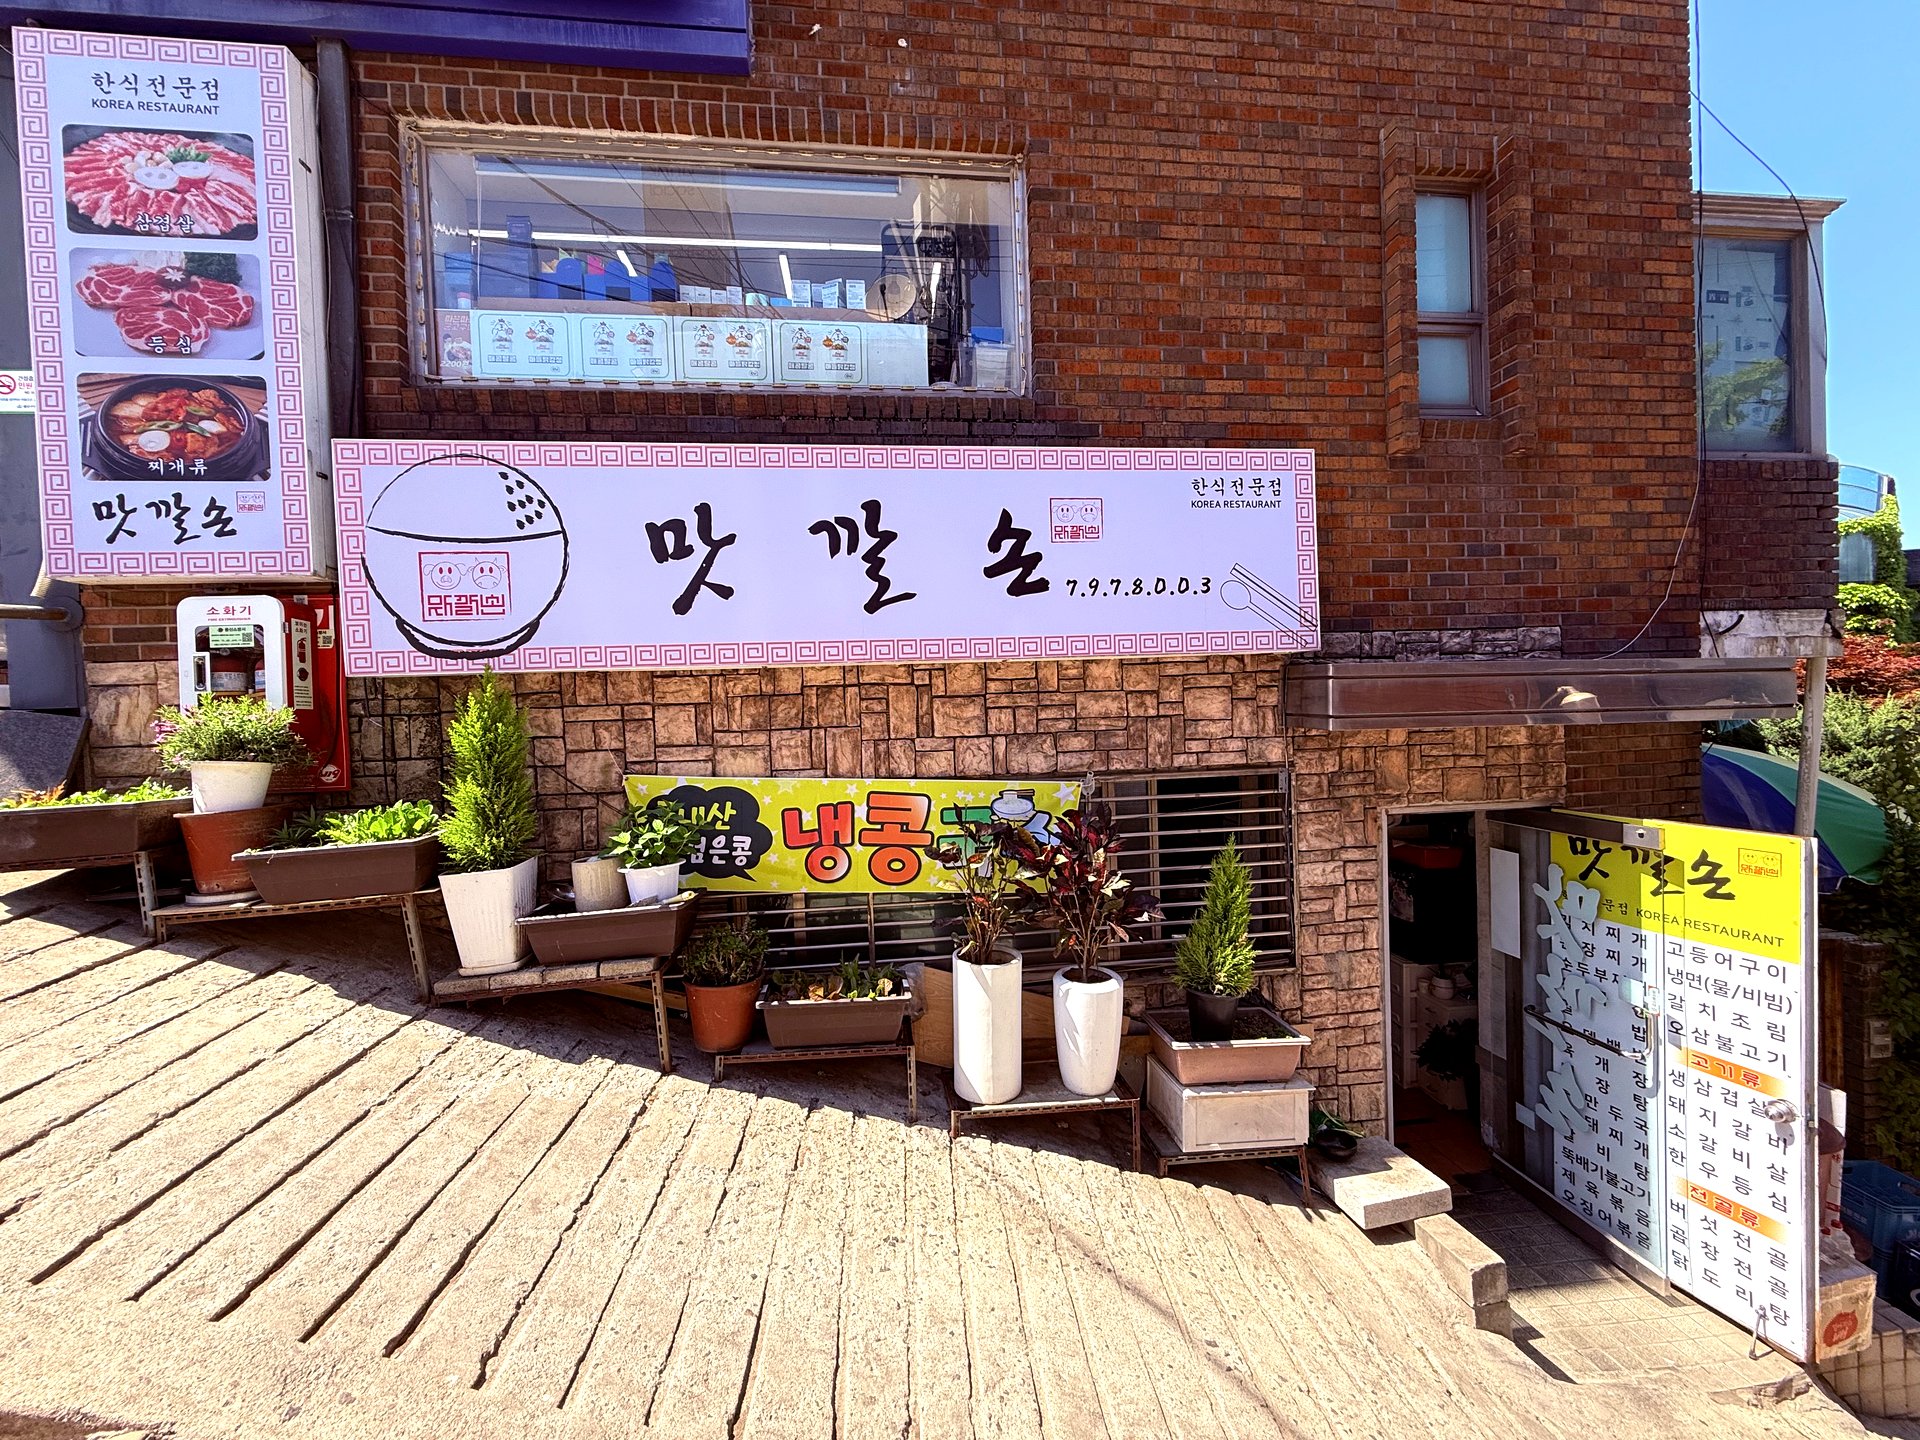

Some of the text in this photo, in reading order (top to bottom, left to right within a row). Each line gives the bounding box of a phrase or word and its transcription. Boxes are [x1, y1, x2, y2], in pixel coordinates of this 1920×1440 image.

[91, 71, 220, 100] 한식전문점
[91, 98, 220, 115] KOREA RESTAURANT
[135, 213, 195, 234] 삼겹살
[147, 336, 192, 354] 등심
[147, 457, 208, 476] 찌개류
[1191, 477, 1281, 497] 한식전문점
[92, 492, 237, 545] 맛깔손
[1191, 500, 1282, 509] KOREA RESTAURANT
[1066, 577, 1211, 597] 7.9.7.8.0.0.3
[206, 606, 251, 616] 소화기
[658, 800, 737, 829] 내산
[1636, 908, 1785, 948] KOREA RESTAURANT
[1560, 941, 1647, 974] 장찌개
[1667, 941, 1786, 984] 고등어구이
[1667, 967, 1792, 1015] 냉면(물/비빔)
[1667, 993, 1786, 1043] 갈치조림
[1667, 1020, 1786, 1072] 오삼불고기
[1691, 1053, 1760, 1087] 고기류
[1668, 1069, 1768, 1118] 생삼겹살
[1668, 1095, 1787, 1156] 돼지갈비
[1562, 1146, 1651, 1206] 뚝배기불고기
[1668, 1124, 1789, 1185] 소갈비살
[1562, 1167, 1651, 1228] 제육볶음
[1668, 1147, 1788, 1213] 한우등심
[1562, 1189, 1652, 1250] 오징어볶음
[1690, 1185, 1759, 1227] 전골류
[1670, 1199, 1789, 1271] 버섯전골
[1670, 1224, 1790, 1300] 곱창전골
[1671, 1250, 1791, 1327] 닭도리탕
